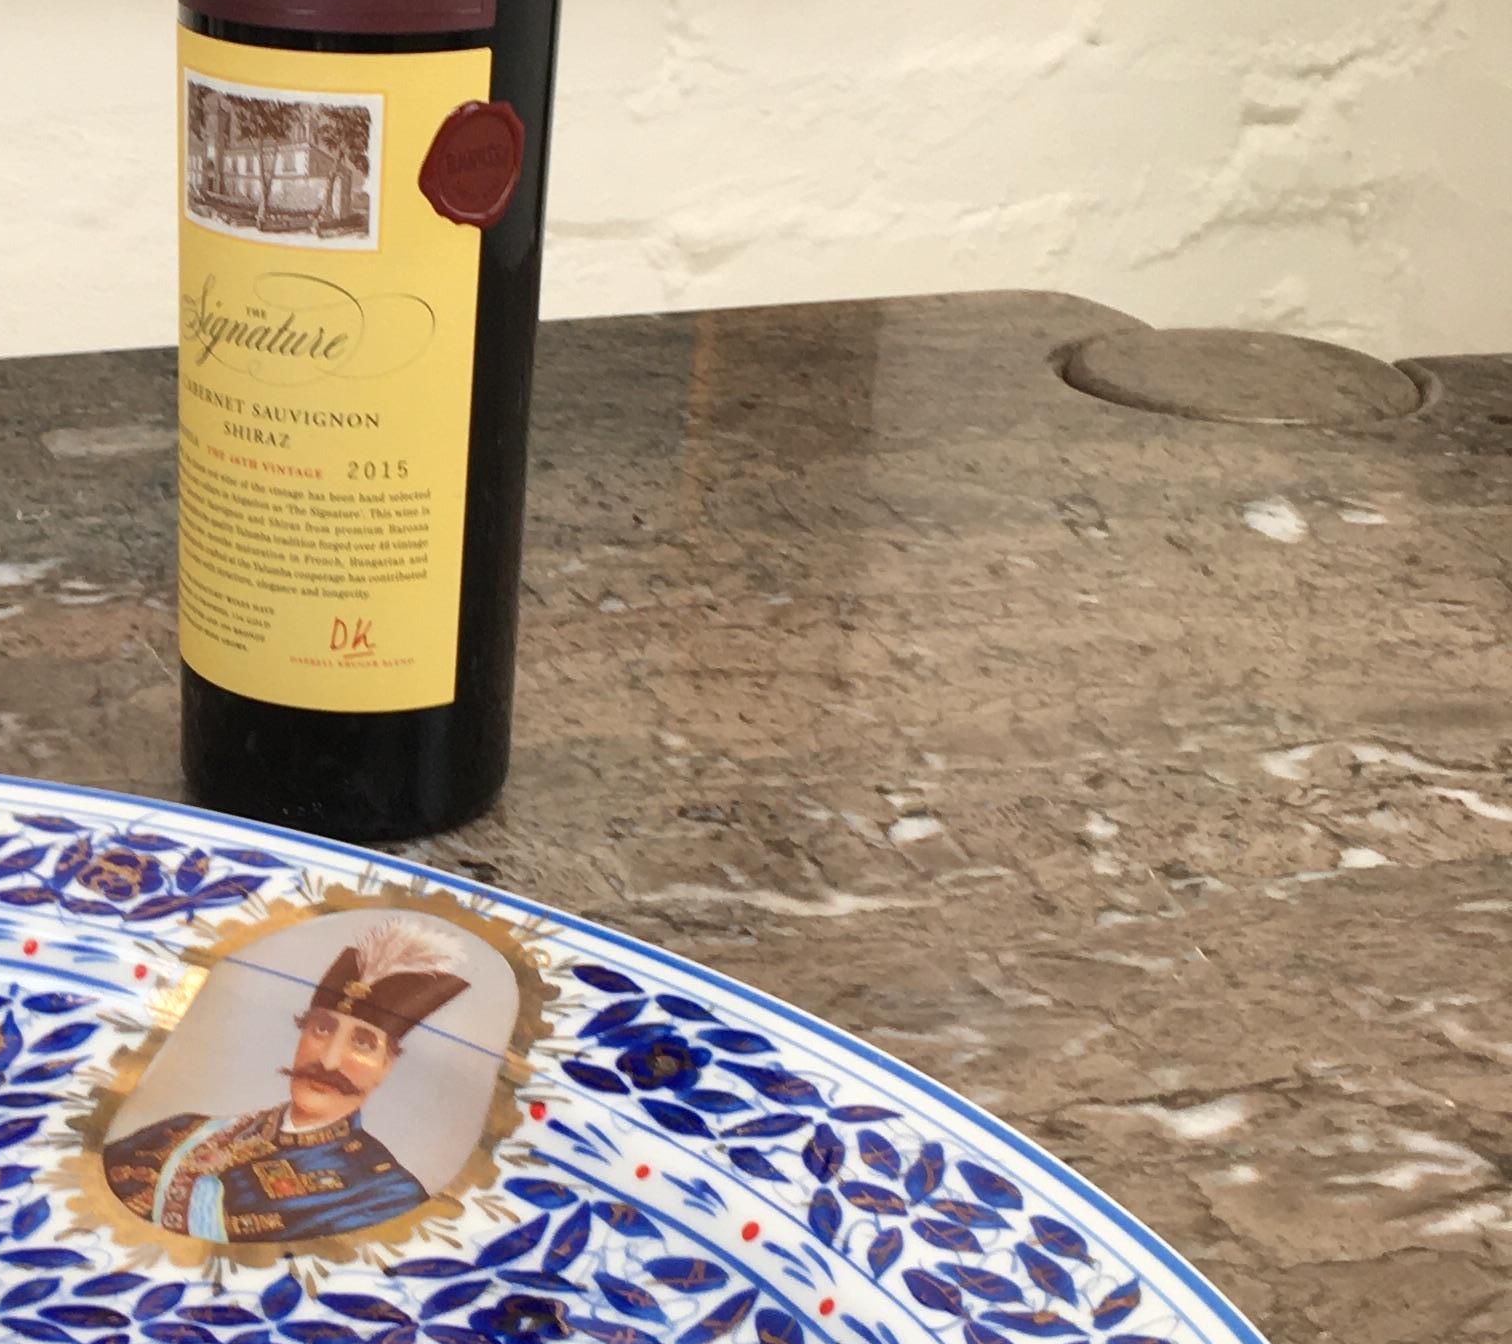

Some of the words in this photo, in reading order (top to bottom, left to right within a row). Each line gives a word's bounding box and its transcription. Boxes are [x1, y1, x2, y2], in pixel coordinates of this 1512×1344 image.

[182, 272, 360, 368] Signature
[245, 306, 268, 320] THE
[252, 403, 381, 429] SAUVIGNON
[223, 421, 291, 449] SHIRAZ
[262, 459, 324, 480] VINTAGE
[347, 460, 409, 480] 2015
[308, 490, 325, 501] has
[329, 491, 354, 503] been
[359, 491, 385, 503] hand
[389, 487, 431, 502] selected
[394, 508, 418, 518] wine
[334, 525, 384, 536] premium
[353, 542, 376, 551] over
[349, 556, 405, 568] Hungarian
[409, 552, 428, 565] and
[348, 572, 366, 583] has
[301, 585, 319, 597] and
